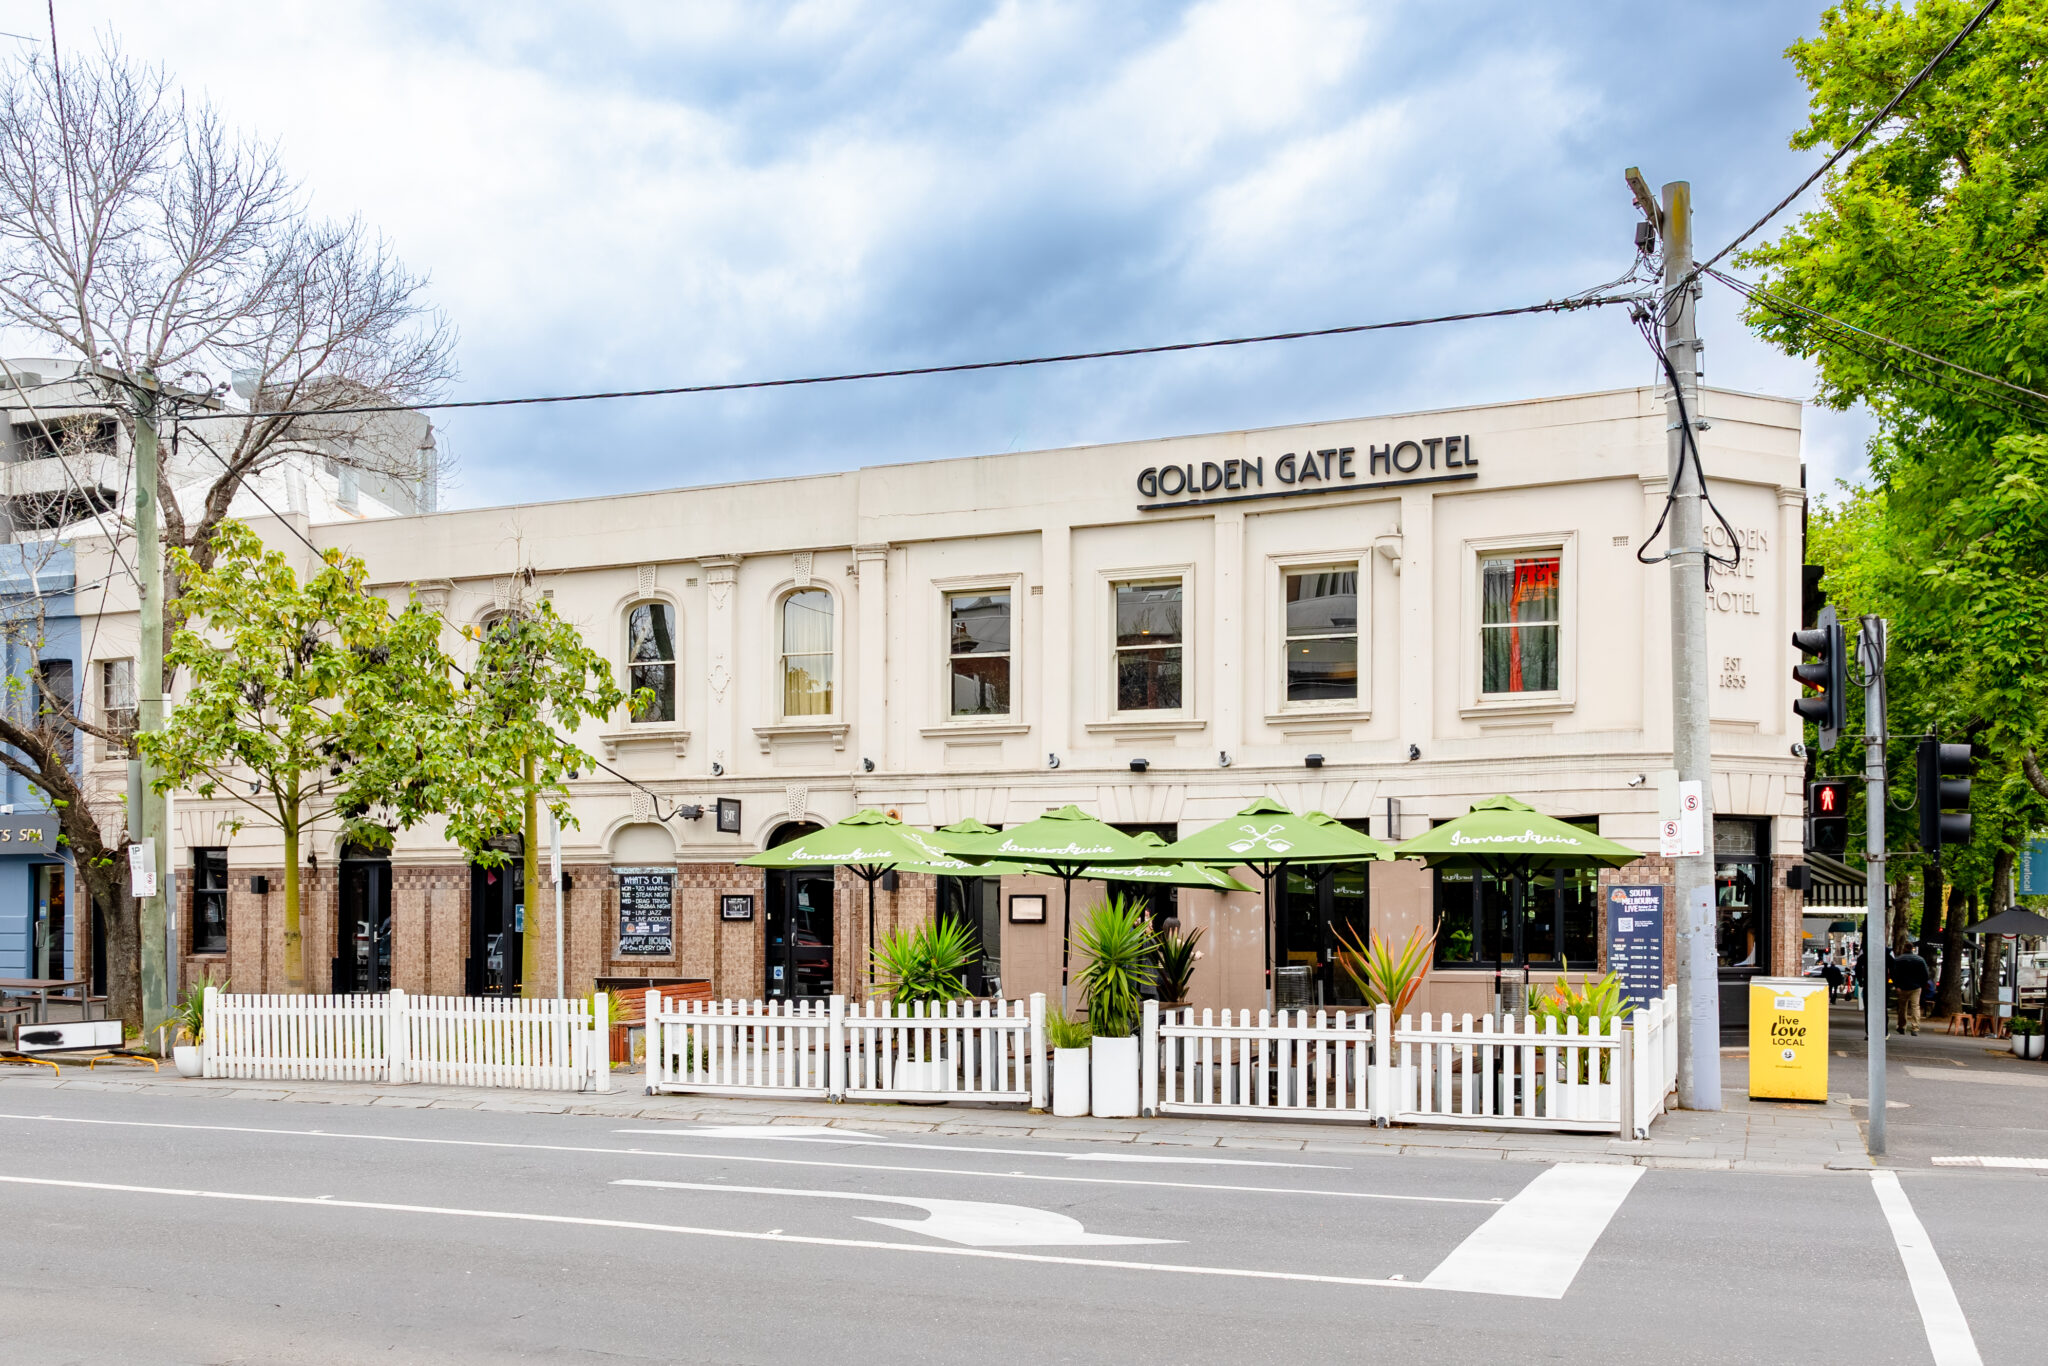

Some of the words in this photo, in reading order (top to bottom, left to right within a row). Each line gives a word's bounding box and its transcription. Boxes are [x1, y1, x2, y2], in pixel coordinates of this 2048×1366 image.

[1136, 457, 1263, 498] GOLDEN
[1274, 447, 1356, 484] GATE
[1370, 434, 1479, 475] HOTEL
[1723, 656, 1742, 672] EST
[19, 829, 43, 841] SPA
[1515, 829, 1582, 846] Squire
[1629, 889, 1651, 897] SOUTH
[1778, 1015, 1799, 1025] live
[1772, 1038, 1805, 1046] LOCAL
